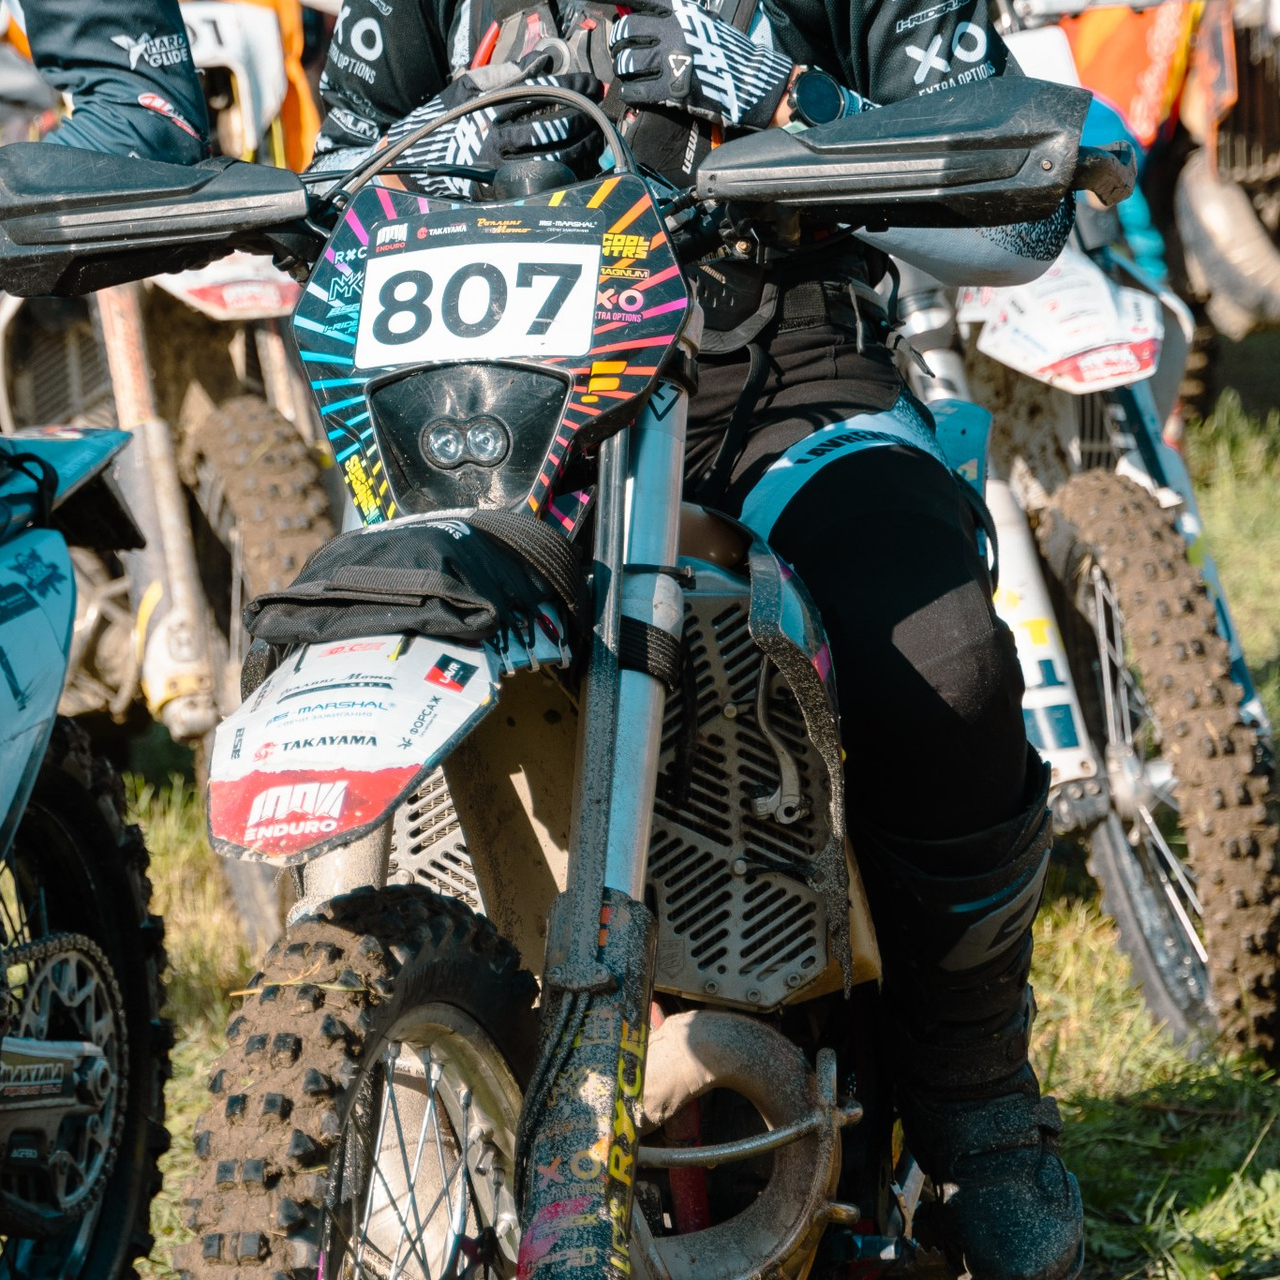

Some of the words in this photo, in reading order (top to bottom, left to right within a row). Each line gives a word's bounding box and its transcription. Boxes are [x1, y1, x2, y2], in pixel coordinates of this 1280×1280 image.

[905, 21, 989, 86] XO
[429, 224, 467, 235] TAKAYAMA
[375, 241, 406, 253] ENDURO
[372, 262, 583, 346] 807
[612, 312, 643, 323] OPTIONS
[281, 735, 378, 752] TAKAYAMA
[243, 819, 338, 841] ENDURO
